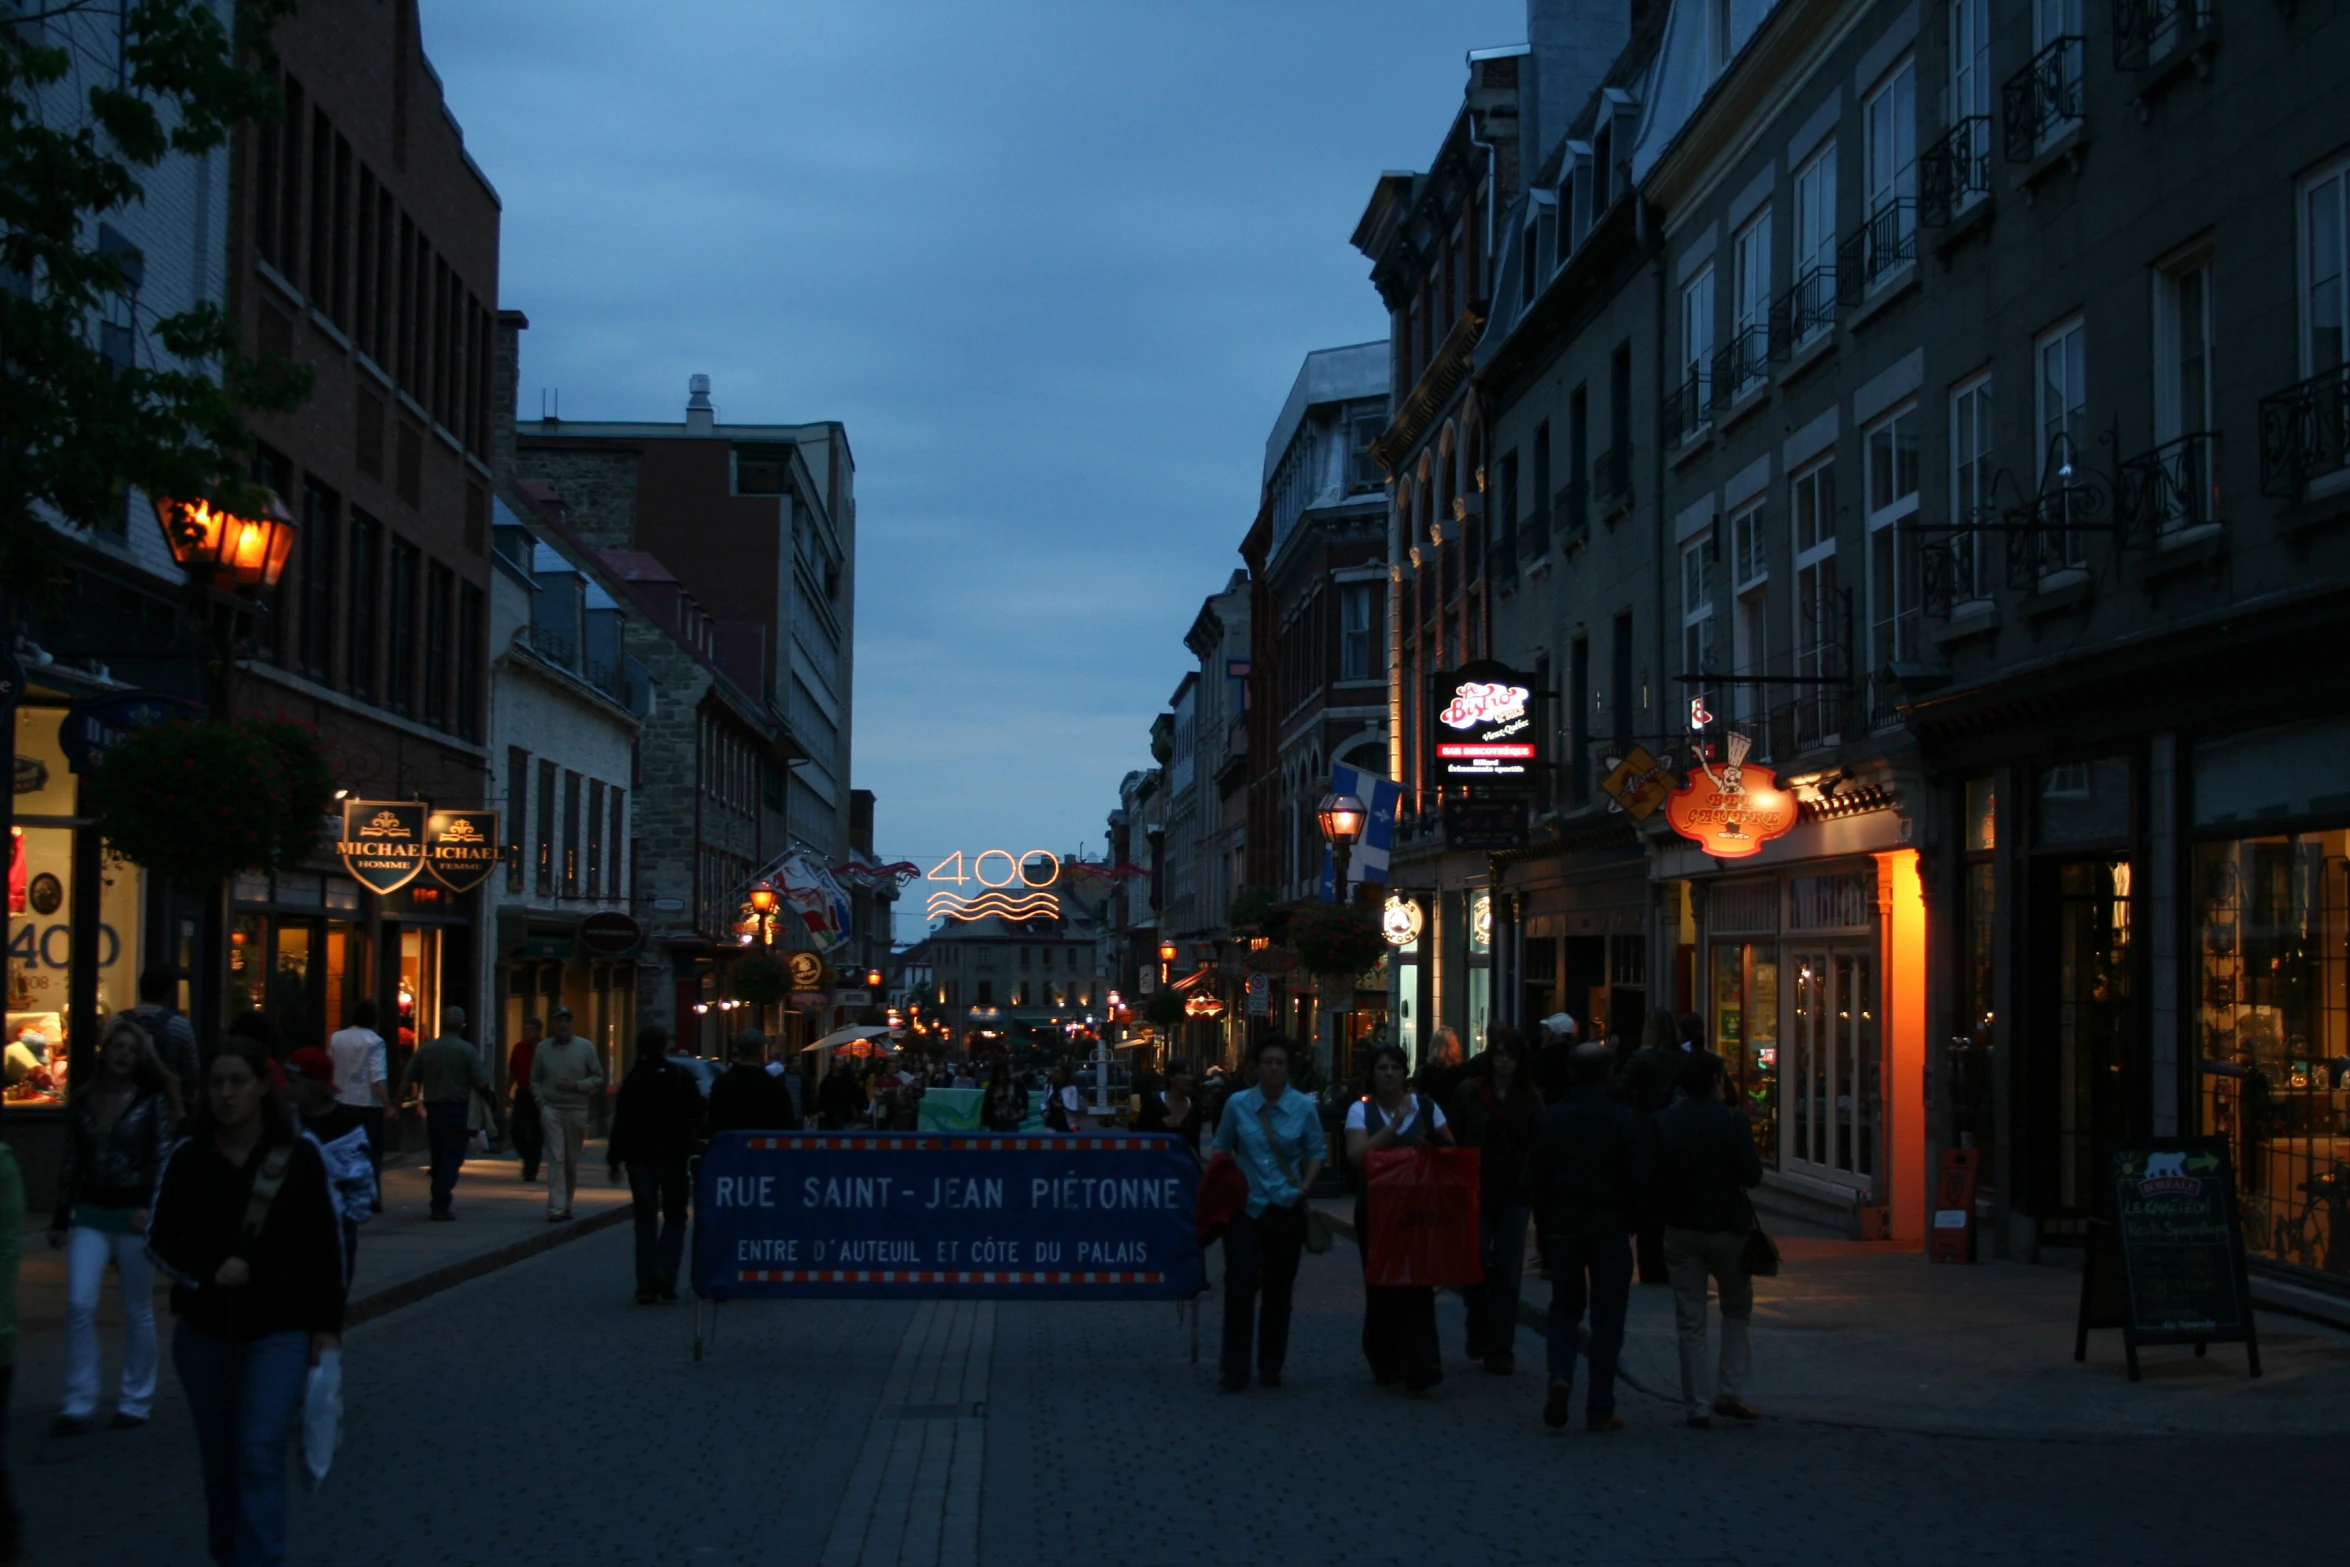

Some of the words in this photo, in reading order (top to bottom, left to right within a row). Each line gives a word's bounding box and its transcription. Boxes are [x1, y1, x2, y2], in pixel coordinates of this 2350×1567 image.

[1441, 685, 1516, 723] Bistro
[1442, 747, 1462, 755] BAR
[336, 841, 433, 857] MICHAEL
[435, 846, 505, 860] ICHAEL
[358, 860, 411, 869] HOMME
[439, 862, 482, 870] FEMME
[927, 849, 1060, 888] 400
[715, 1175, 776, 1209] RUE
[1031, 1170, 1181, 1210] PIÉTONNE
[737, 1239, 798, 1261] ENTRE
[936, 1240, 958, 1261] ET
[971, 1236, 1020, 1263] CÔTE
[1034, 1241, 1062, 1262] DU
[1077, 1241, 1147, 1263] PALAIS
